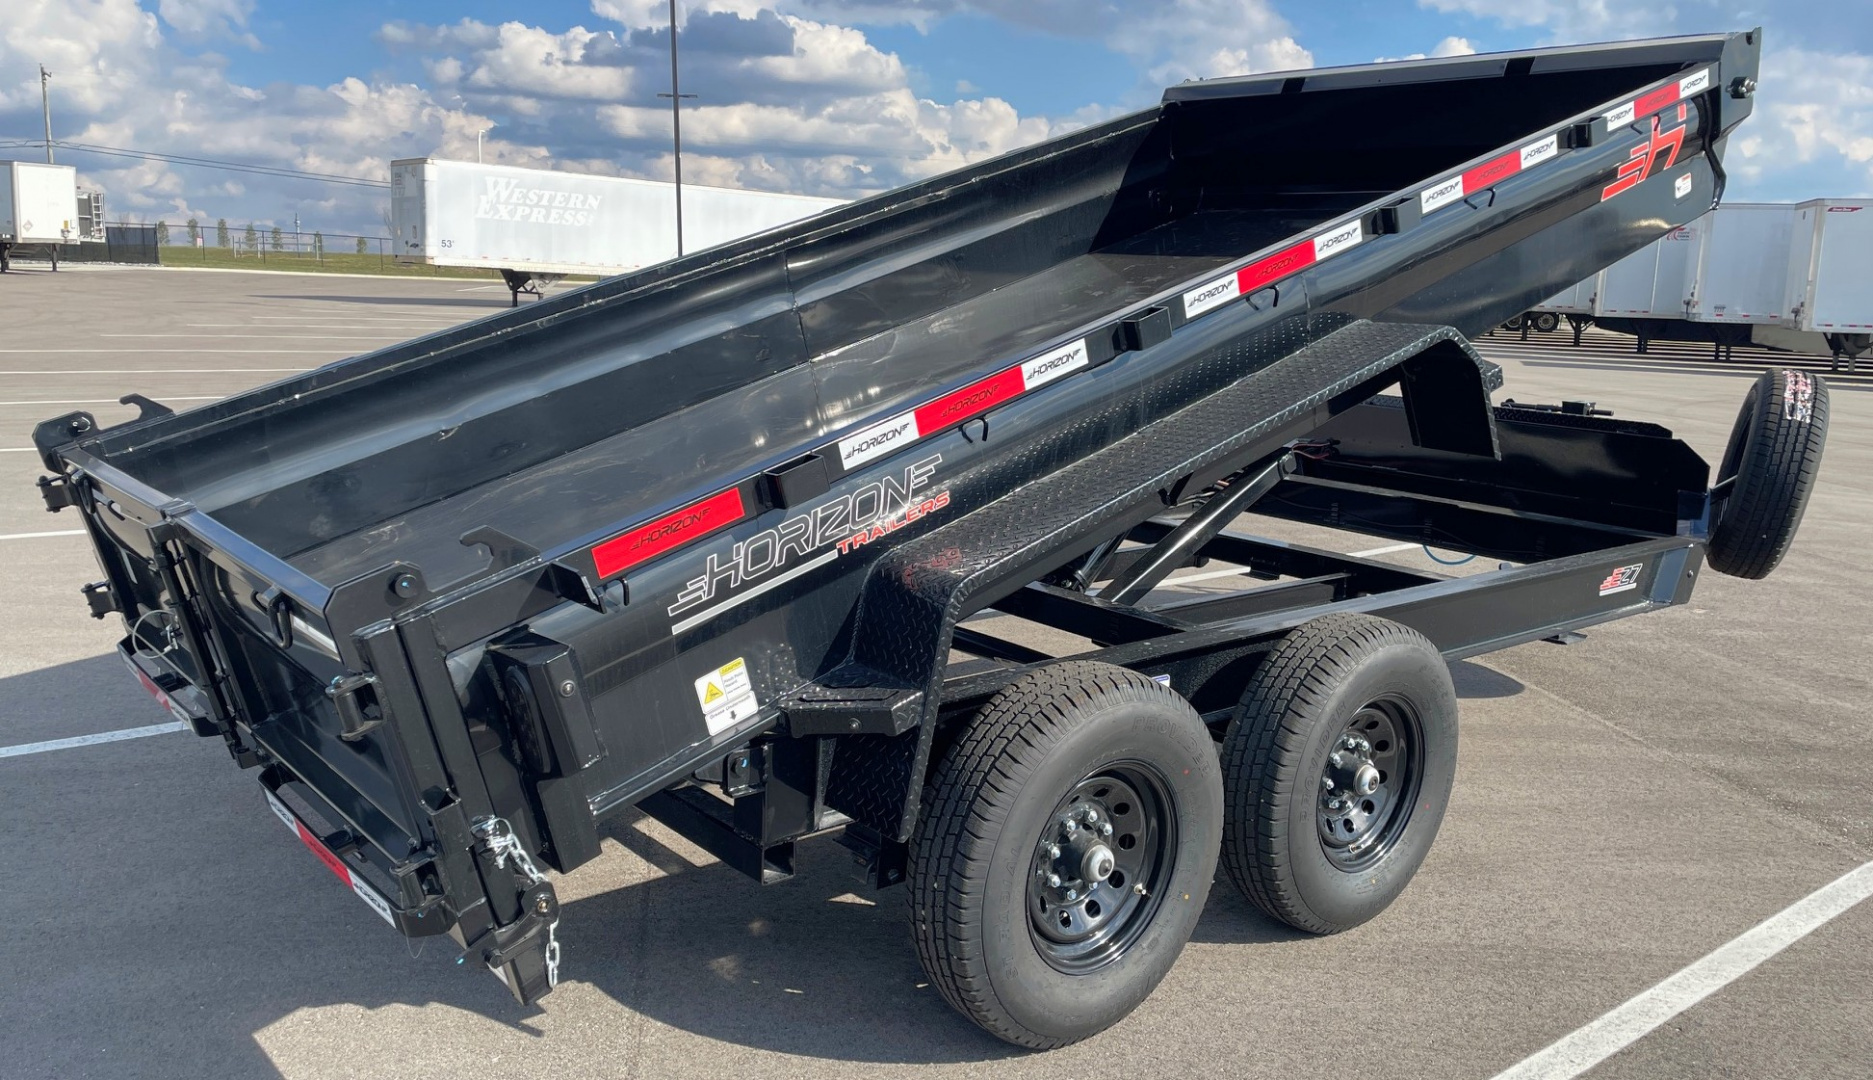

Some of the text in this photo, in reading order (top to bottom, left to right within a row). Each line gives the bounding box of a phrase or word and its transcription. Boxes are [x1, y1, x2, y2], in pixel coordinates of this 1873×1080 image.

[1525, 142, 1552, 159] HORIZON
[1427, 183, 1458, 201] HORIZON
[1320, 229, 1356, 251] HORIZON
[1259, 255, 1296, 277] HORIZON
[1190, 281, 1231, 305] HORIZON
[1029, 351, 1078, 380] HORIZON
[944, 386, 996, 416] HORIZON
[848, 425, 905, 459] HORIZON
[635, 510, 706, 550] HORIZON
[686, 460, 930, 606] HORIZON
[836, 490, 951, 555] TRAILERS
